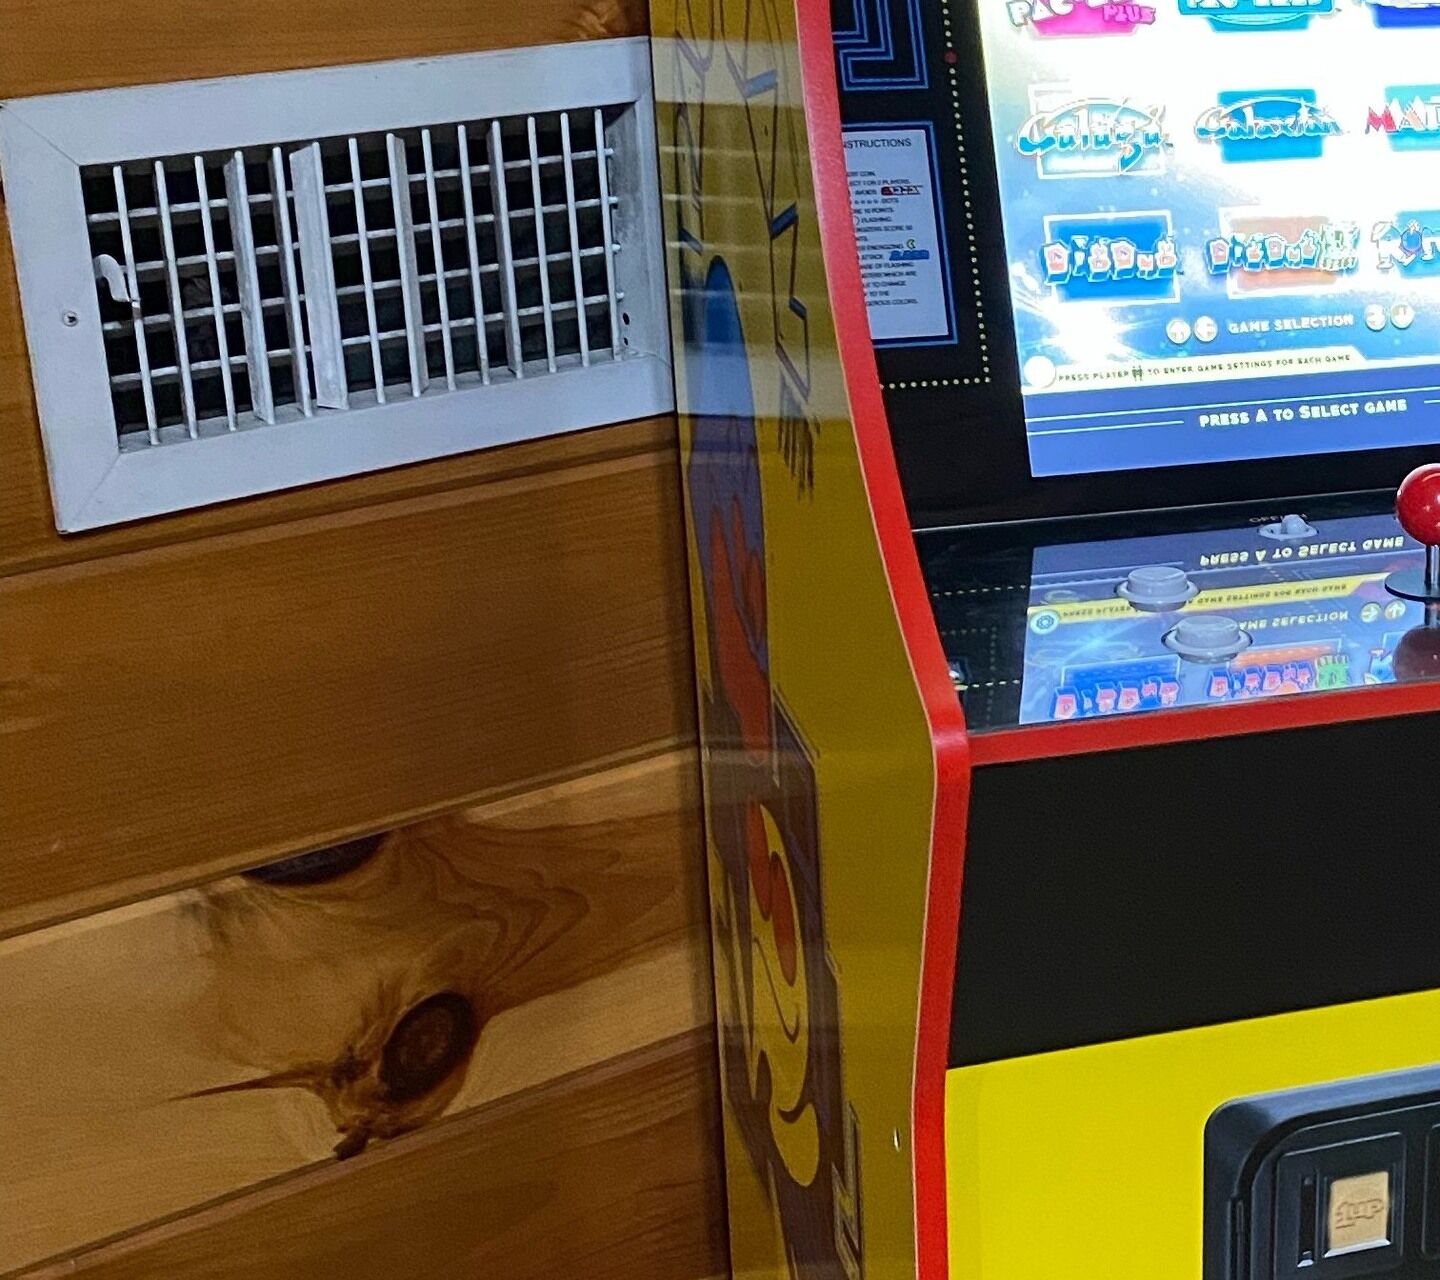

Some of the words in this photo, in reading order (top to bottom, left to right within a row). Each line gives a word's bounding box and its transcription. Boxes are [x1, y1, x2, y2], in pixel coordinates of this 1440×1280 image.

[1228, 319, 1269, 334] GAME
[1274, 314, 1354, 331] SELECTION
[1163, 366, 1194, 374] ENTER
[1197, 363, 1223, 372] GAME
[1227, 360, 1273, 370] SETTINGS
[1276, 358, 1294, 366] FOR
[1297, 356, 1322, 365] EACH
[1325, 354, 1351, 363] GAME
[1199, 411, 1250, 428] PRESS
[1255, 409, 1269, 423] A
[1273, 407, 1294, 422] TO
[1299, 402, 1359, 419] SELECT
[1364, 399, 1407, 415] GAME
